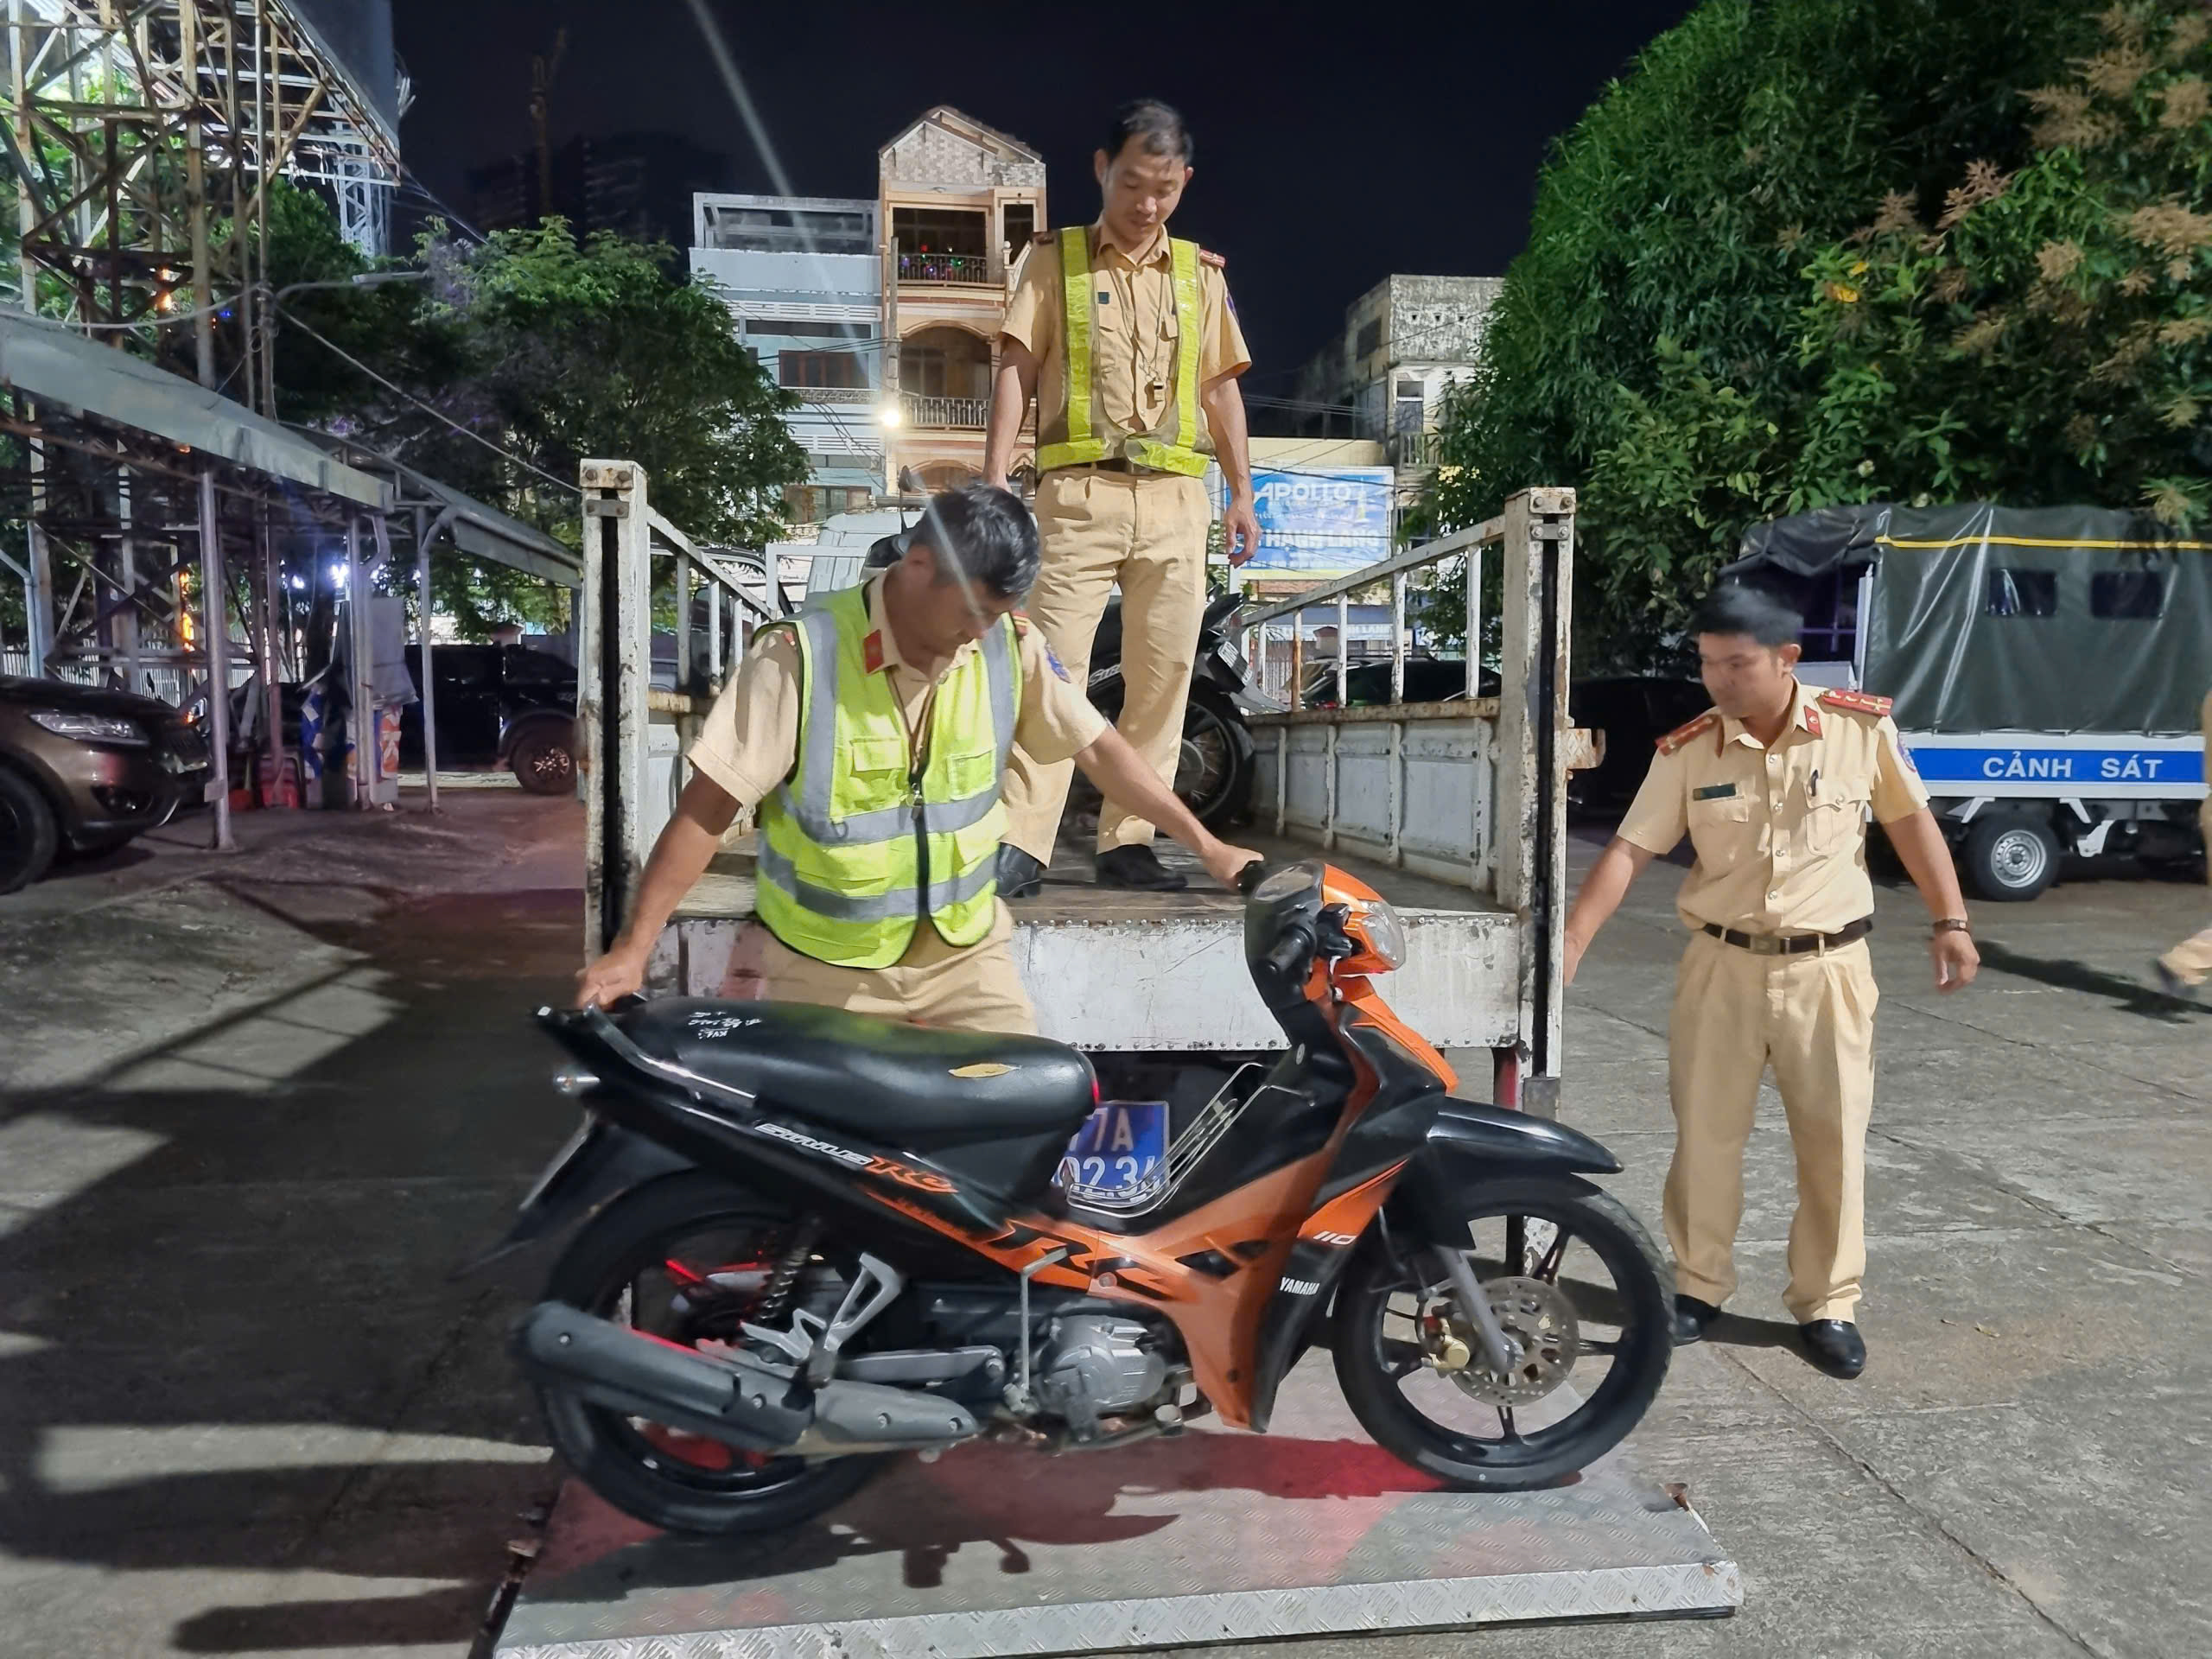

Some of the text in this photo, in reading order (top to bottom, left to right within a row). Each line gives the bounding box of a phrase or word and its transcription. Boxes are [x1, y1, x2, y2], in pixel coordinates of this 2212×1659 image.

[1254, 482, 1351, 504] APOLLO
[1982, 750, 2164, 779] CẢNH SÁT
[1313, 1230, 1357, 1245] 110
